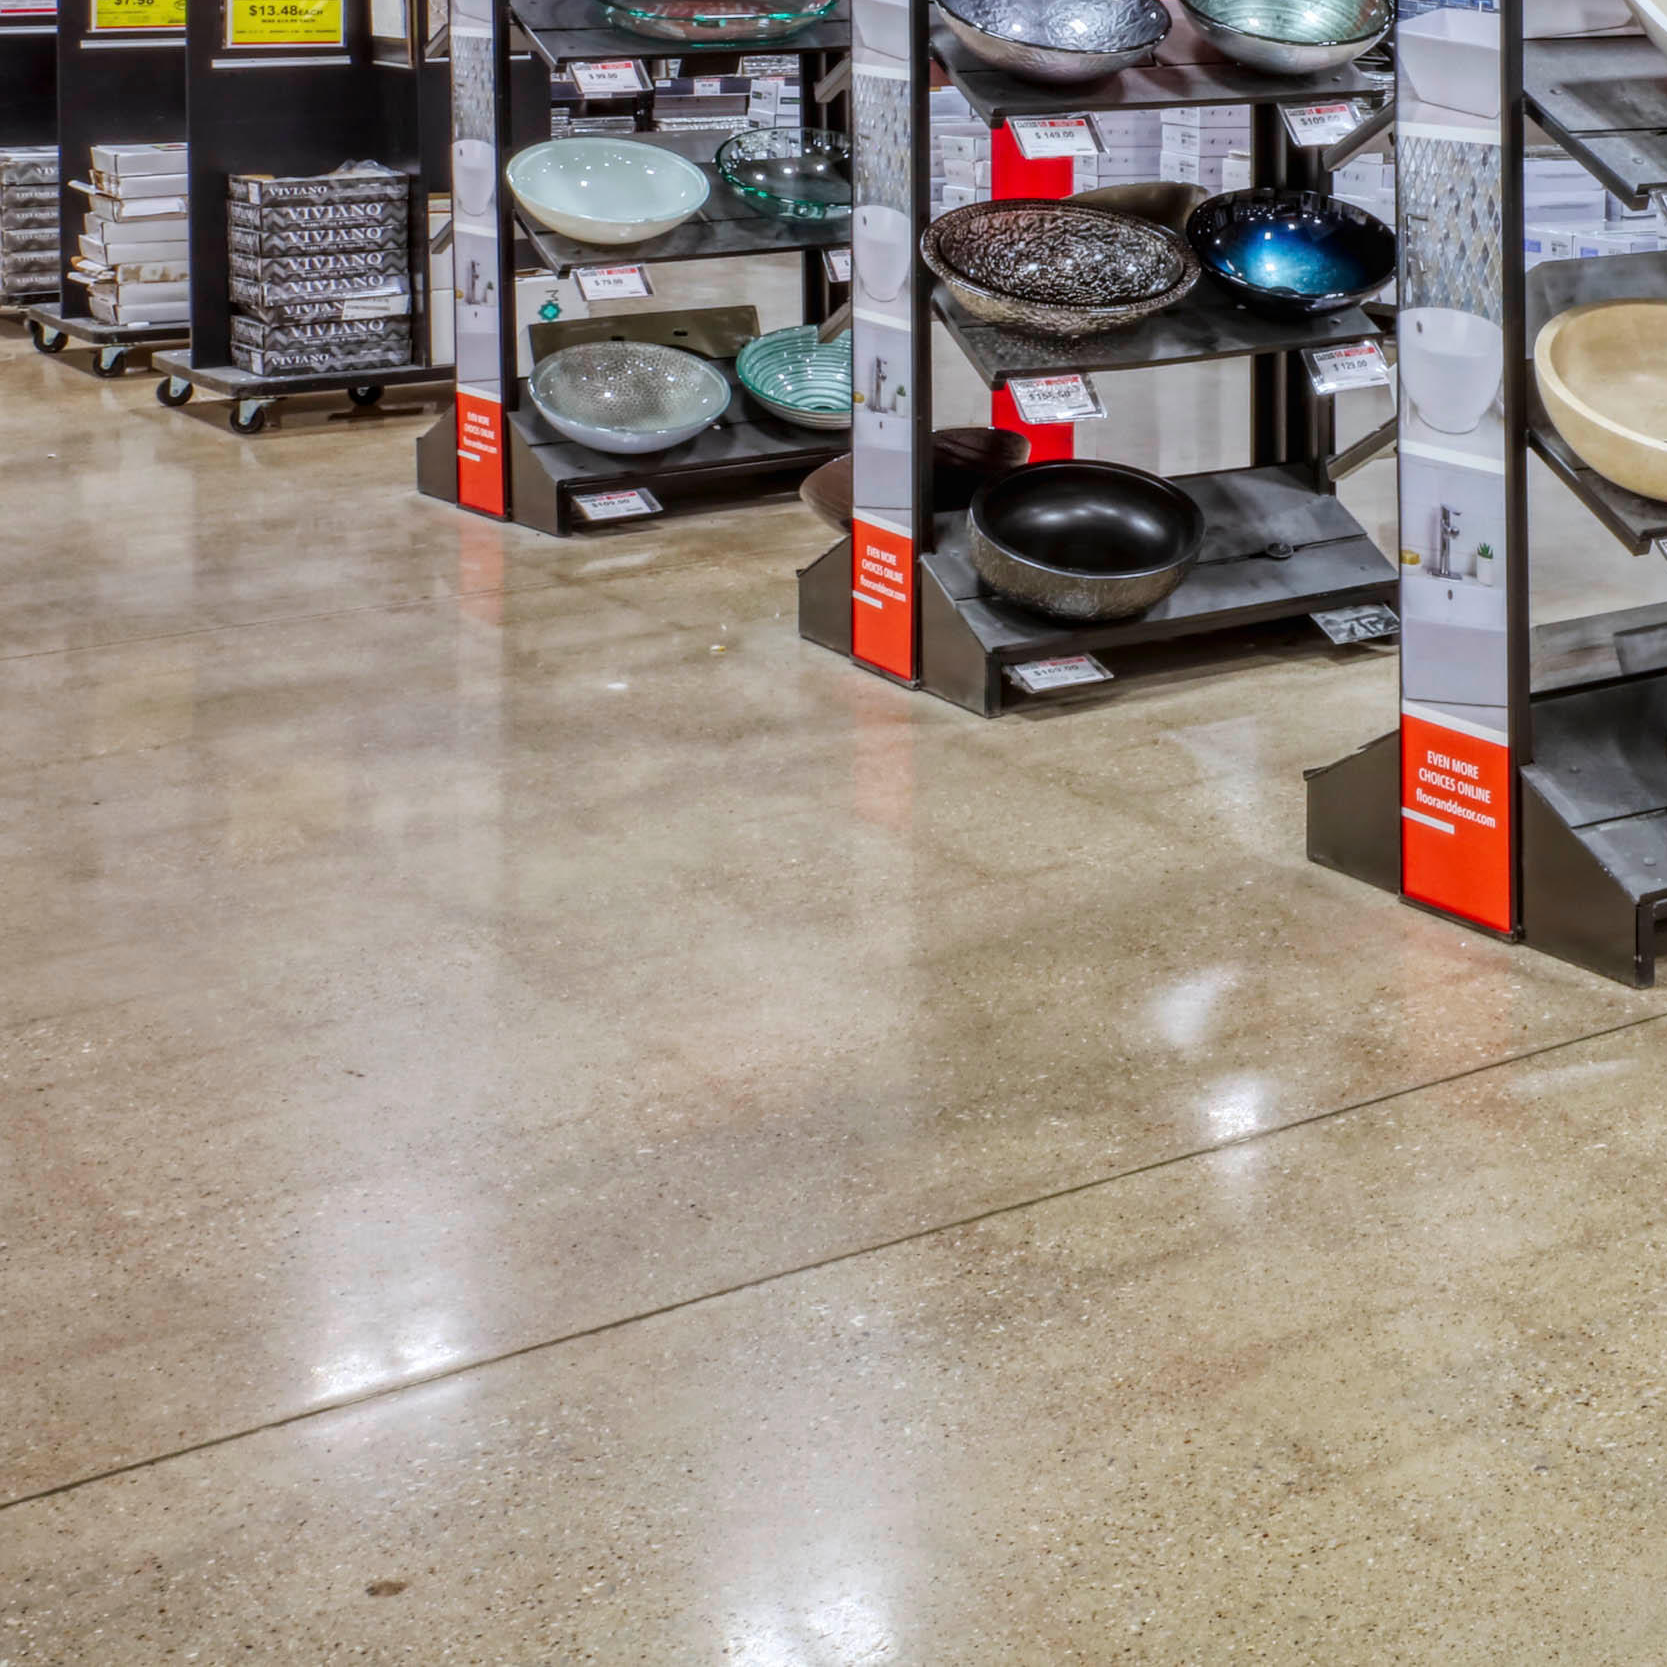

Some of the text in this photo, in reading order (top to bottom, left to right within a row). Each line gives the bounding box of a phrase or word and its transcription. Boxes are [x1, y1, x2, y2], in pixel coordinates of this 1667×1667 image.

[269, 186, 327, 197] VIVIANO
[286, 202, 383, 220] VIVIANO
[286, 226, 383, 243] VIVIANO
[286, 253, 384, 271] VIVIANO
[289, 275, 384, 294] VIVIANO
[283, 301, 344, 315] VIVIAN
[289, 319, 384, 337] VIVIANO
[271, 354, 329, 365] VIVIANO
[1427, 750, 1479, 780] EVEN MORE
[1419, 768, 1491, 804] CHOICES ONLINE
[1416, 787, 1496, 828] flooranddecor.com
